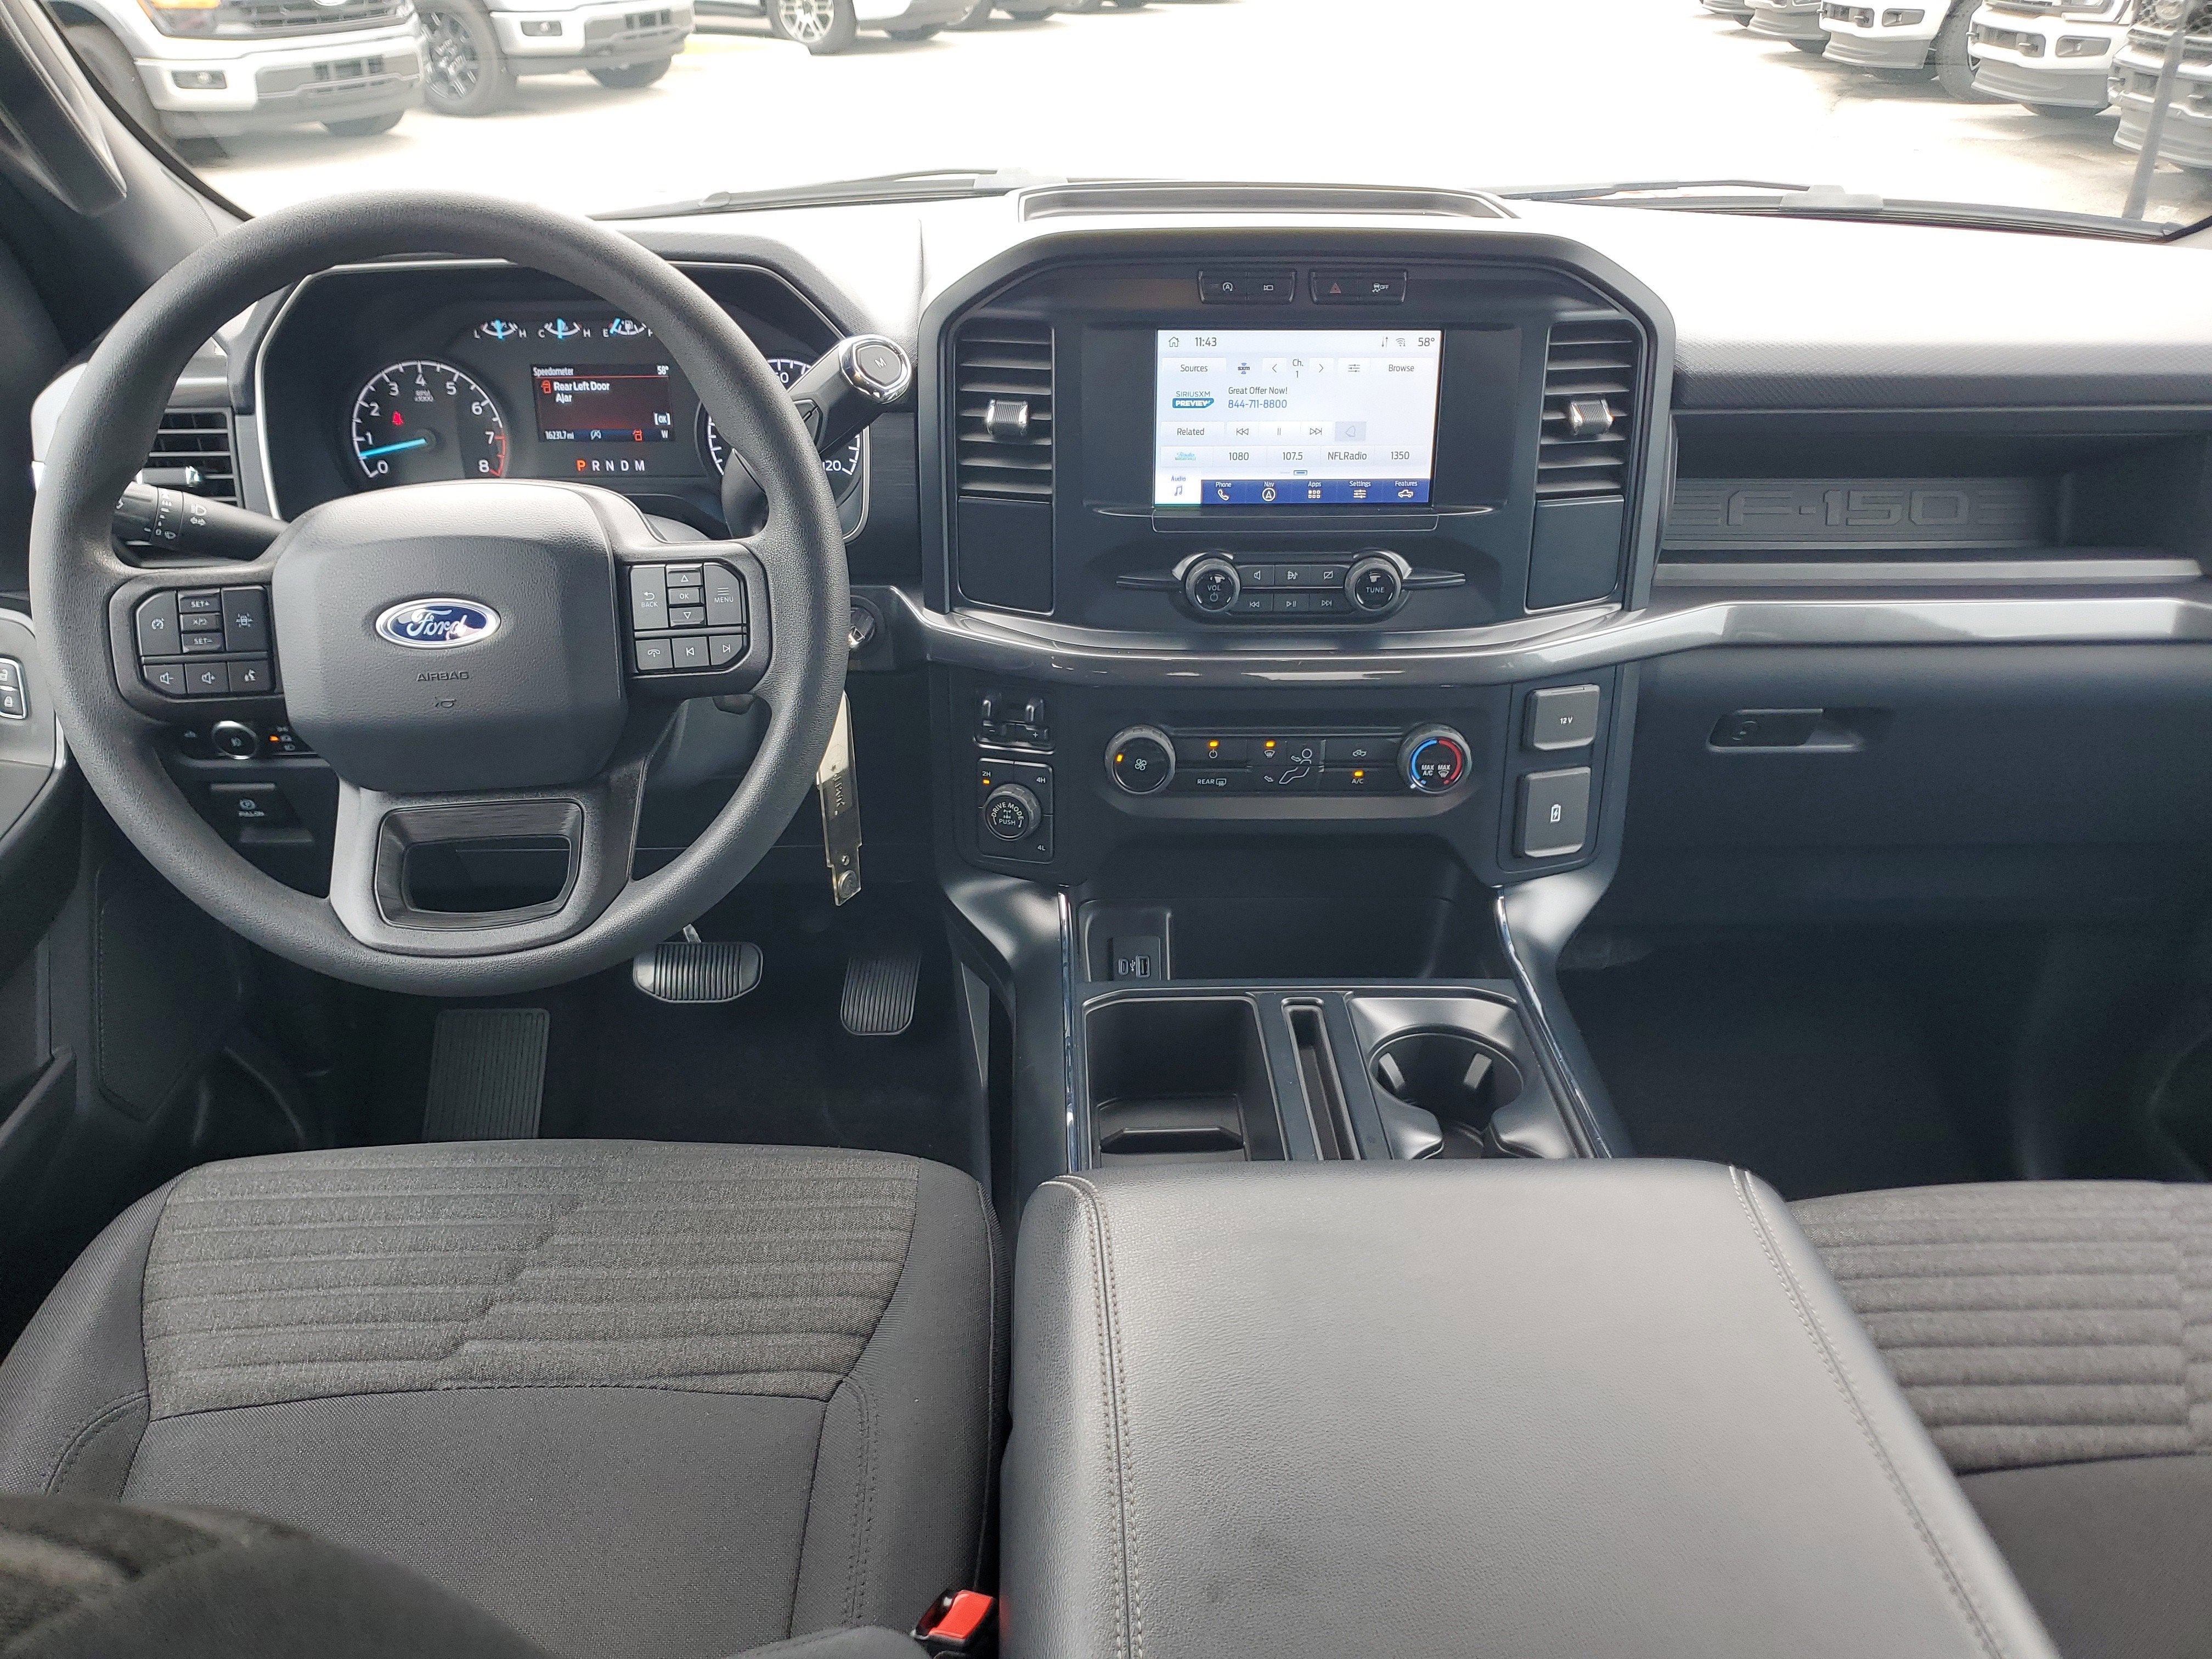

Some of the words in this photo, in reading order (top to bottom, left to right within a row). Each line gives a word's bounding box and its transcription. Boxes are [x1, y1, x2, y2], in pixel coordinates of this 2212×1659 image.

[1195, 337, 1217, 347] 11:43
[1418, 337, 1435, 347] 58°
[874, 358, 887, 368] M
[533, 366, 574, 377] Speedometer
[415, 374, 426, 386] 4
[389, 381, 399, 396] 3
[445, 381, 456, 395] 5
[554, 381, 572, 391] Rear
[573, 381, 590, 391] Left
[590, 381, 610, 391] Door
[1249, 386, 1267, 394] Offer
[1268, 386, 1288, 394] Now!
[556, 393, 572, 404] Ajar
[1228, 399, 1287, 408] 844-711-8800
[369, 402, 381, 416] 2
[471, 402, 482, 415] 6
[1177, 427, 1205, 436] Related
[365, 432, 373, 445] 1
[485, 431, 494, 444] 7
[1228, 452, 1249, 461] 1080
[1282, 452, 1303, 460] 107.5
[1328, 451, 1367, 460] NFLRadio
[1391, 451, 1409, 460] 1350
[377, 460, 388, 473] 0
[478, 459, 489, 473] 8
[577, 460, 586, 471] P
[592, 460, 601, 471] R
[606, 460, 615, 471] N
[620, 460, 629, 471] D
[635, 460, 645, 471] M
[1726, 490, 1970, 527] F-150
[406, 608, 468, 637] Ford
[417, 671, 470, 681] AIRBAG
[991, 802, 1007, 818] DRIVE
[1007, 802, 1024, 821] MODE
